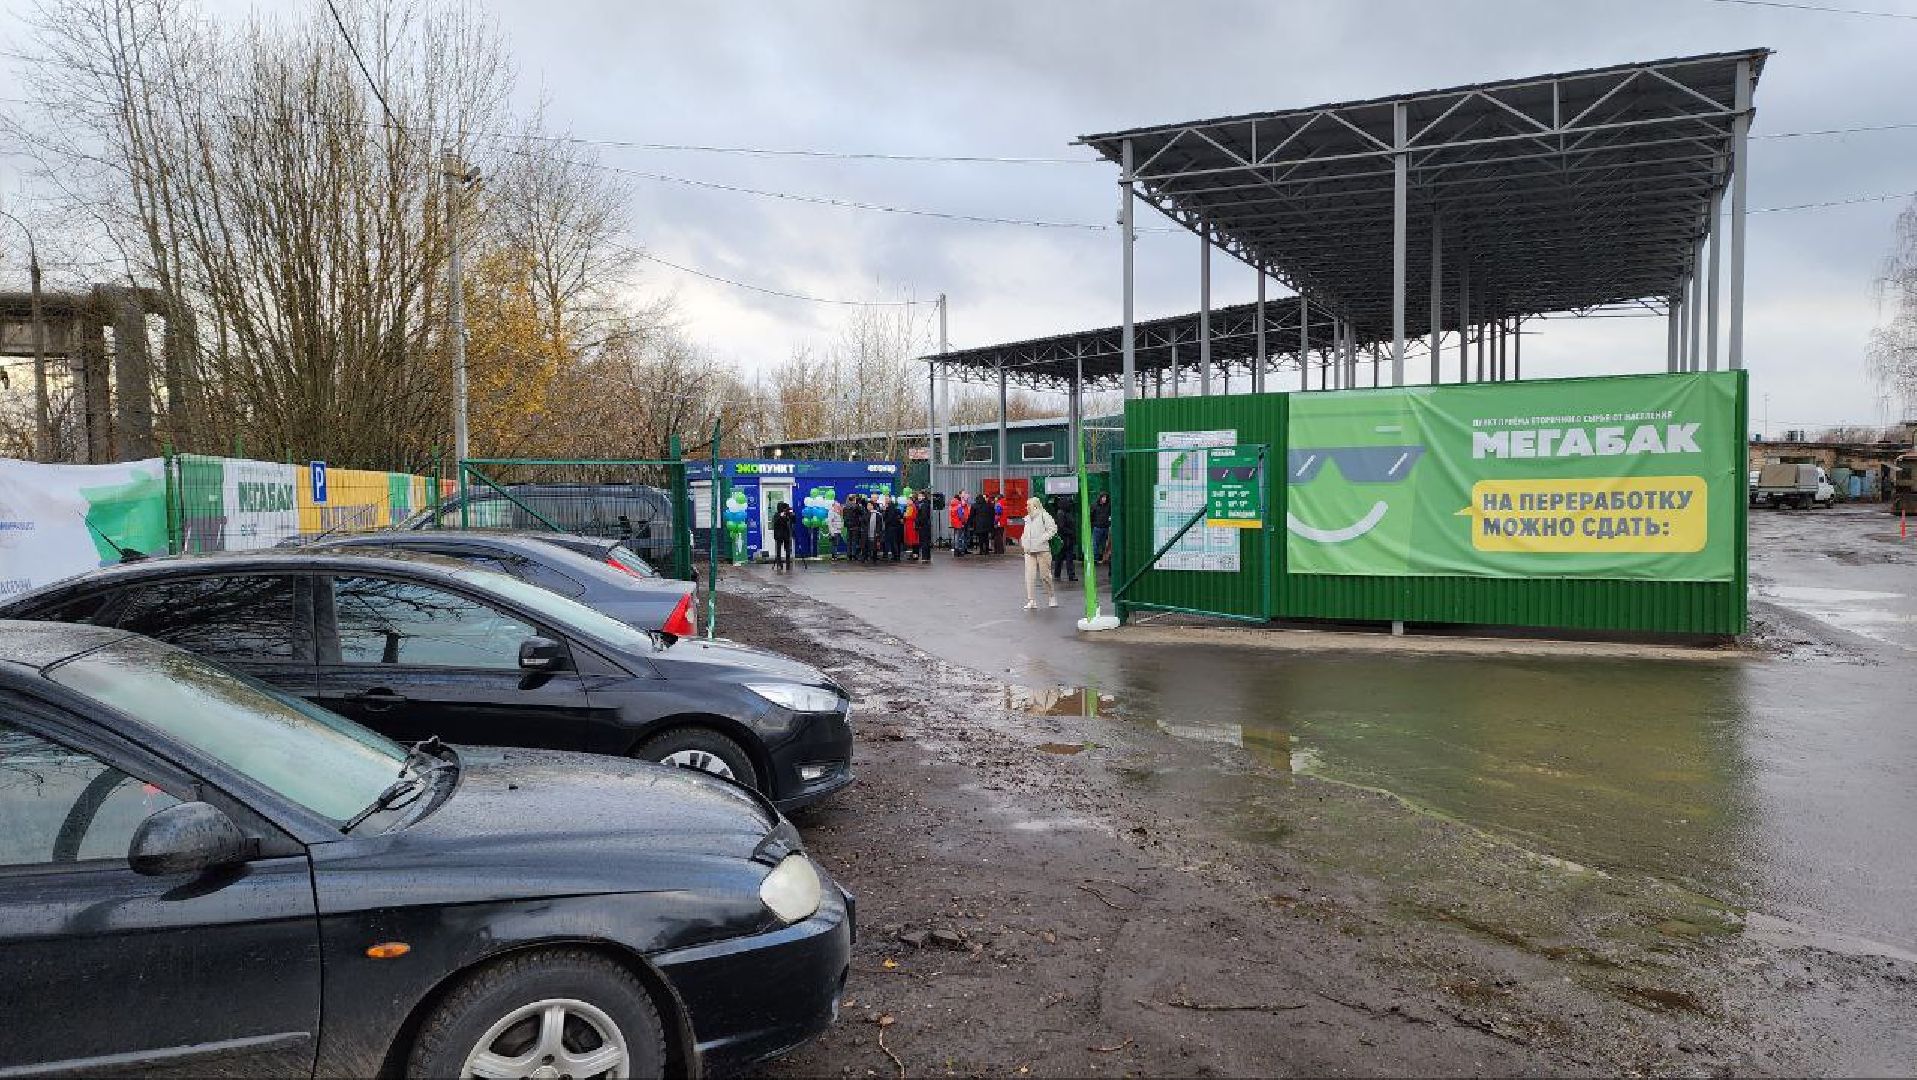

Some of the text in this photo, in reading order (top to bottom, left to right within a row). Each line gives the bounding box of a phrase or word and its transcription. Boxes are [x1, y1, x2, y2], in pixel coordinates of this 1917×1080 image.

[1472, 422, 1702, 459] МЕГАБАК
[735, 463, 796, 474] ЭКОПУНКТ
[315, 466, 324, 499] P
[1482, 490, 1694, 511] НА ПЕРЕРАБОТКУ
[1482, 517, 1670, 540] МОЖНО СДАТЬ:
